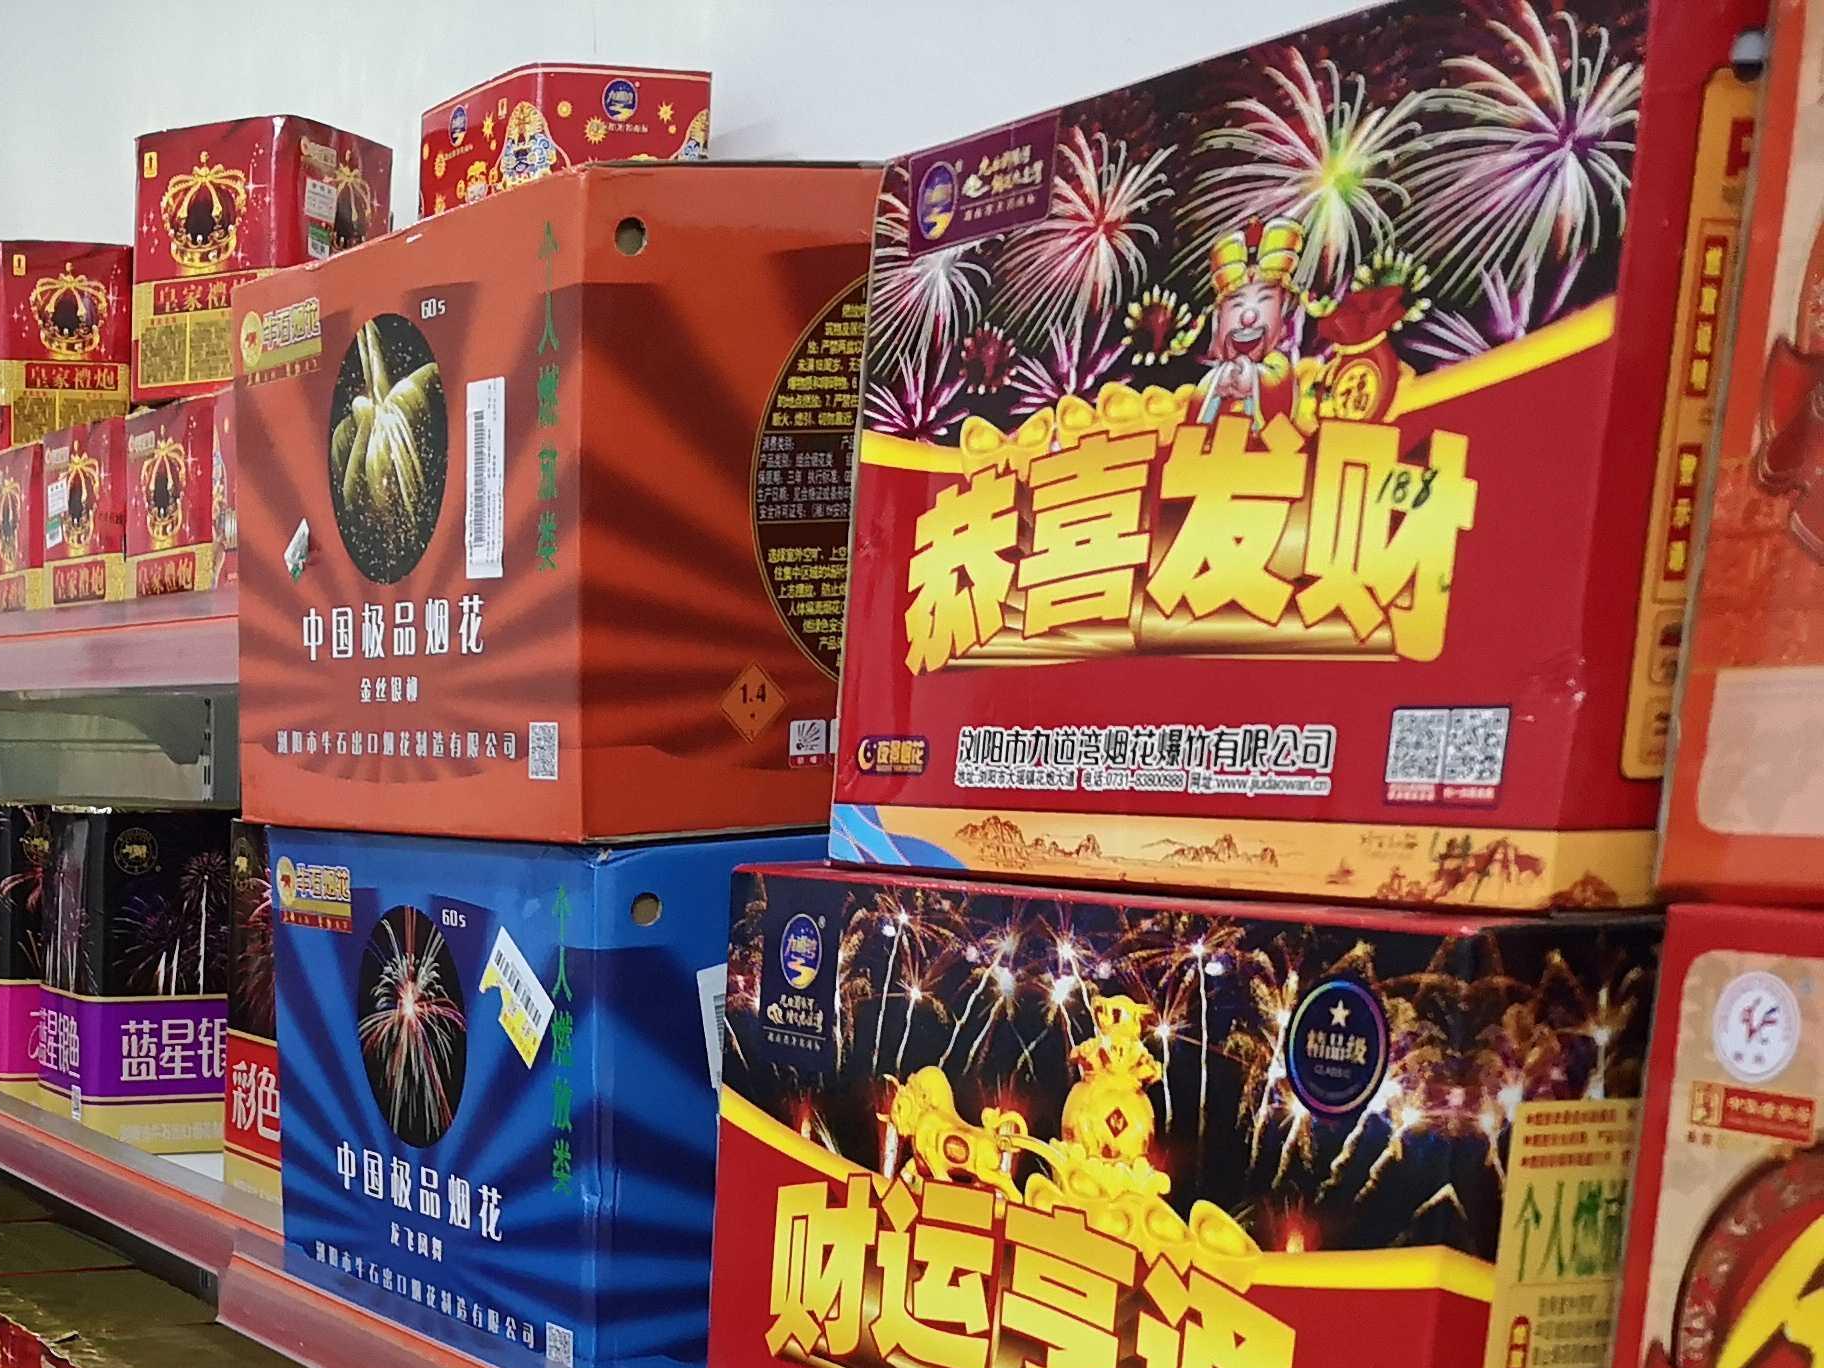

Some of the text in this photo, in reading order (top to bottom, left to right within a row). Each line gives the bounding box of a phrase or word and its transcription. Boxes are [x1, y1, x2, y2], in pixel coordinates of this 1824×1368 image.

[420, 299, 447, 319] 60s
[30, 366, 116, 390] 皇家禮炮
[904, 411, 1478, 676] 恭喜发财
[302, 594, 485, 661] 中国极品烟花
[740, 683, 766, 704] 1.4
[959, 728, 1334, 769] 浏阳市九道湾烟花爆竹有限公司
[441, 908, 467, 929] 60s
[337, 1140, 503, 1242] 中国极品烟花
